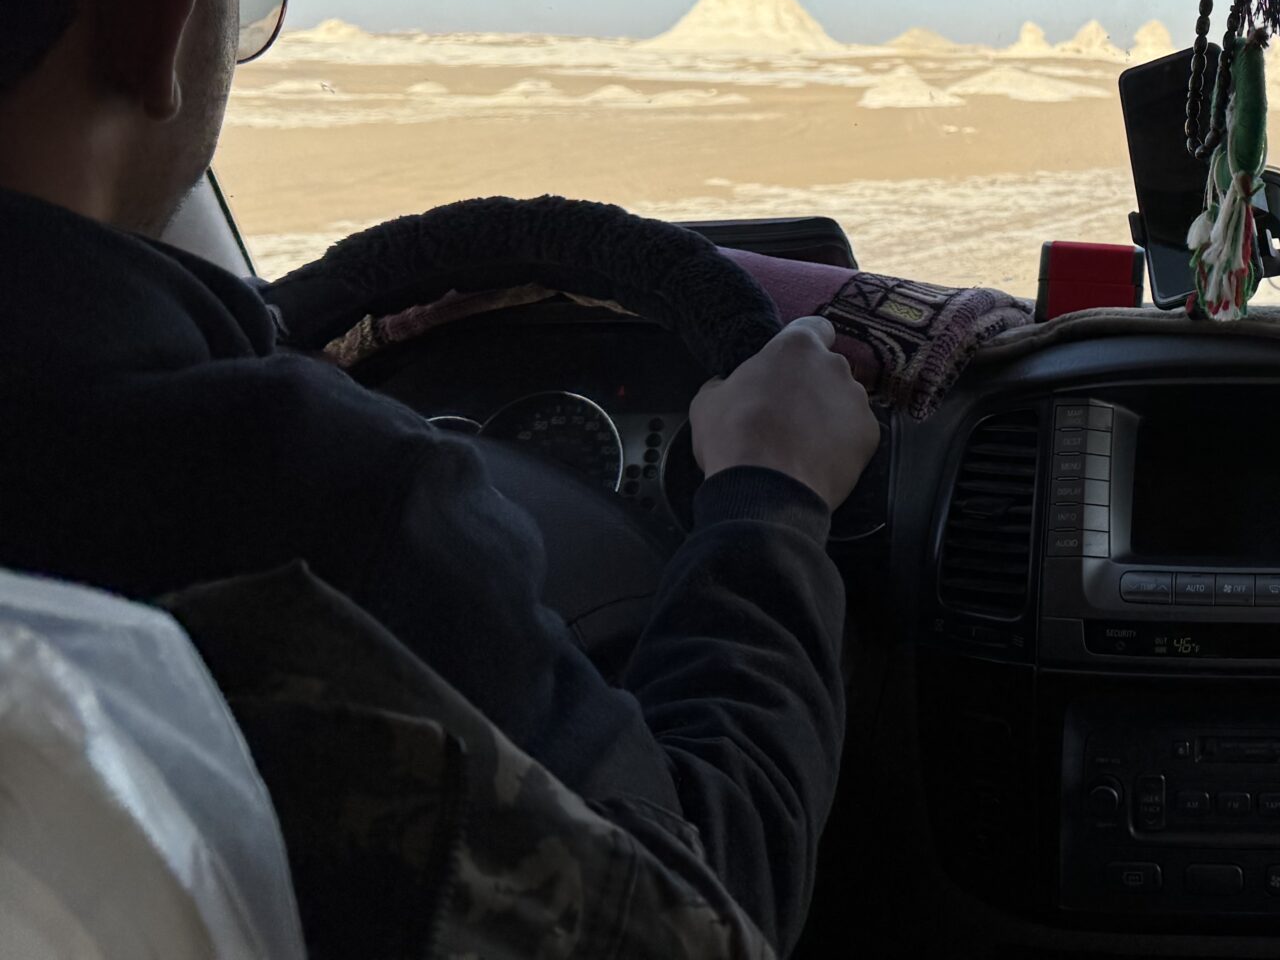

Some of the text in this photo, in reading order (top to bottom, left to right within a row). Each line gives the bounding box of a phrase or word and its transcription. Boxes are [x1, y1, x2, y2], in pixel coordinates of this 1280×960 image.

[1056, 539, 1079, 547] AUDIO
[1186, 584, 1205, 592] AUTO
[1233, 585, 1246, 593] OFF
[1106, 629, 1136, 638] SECURITY
